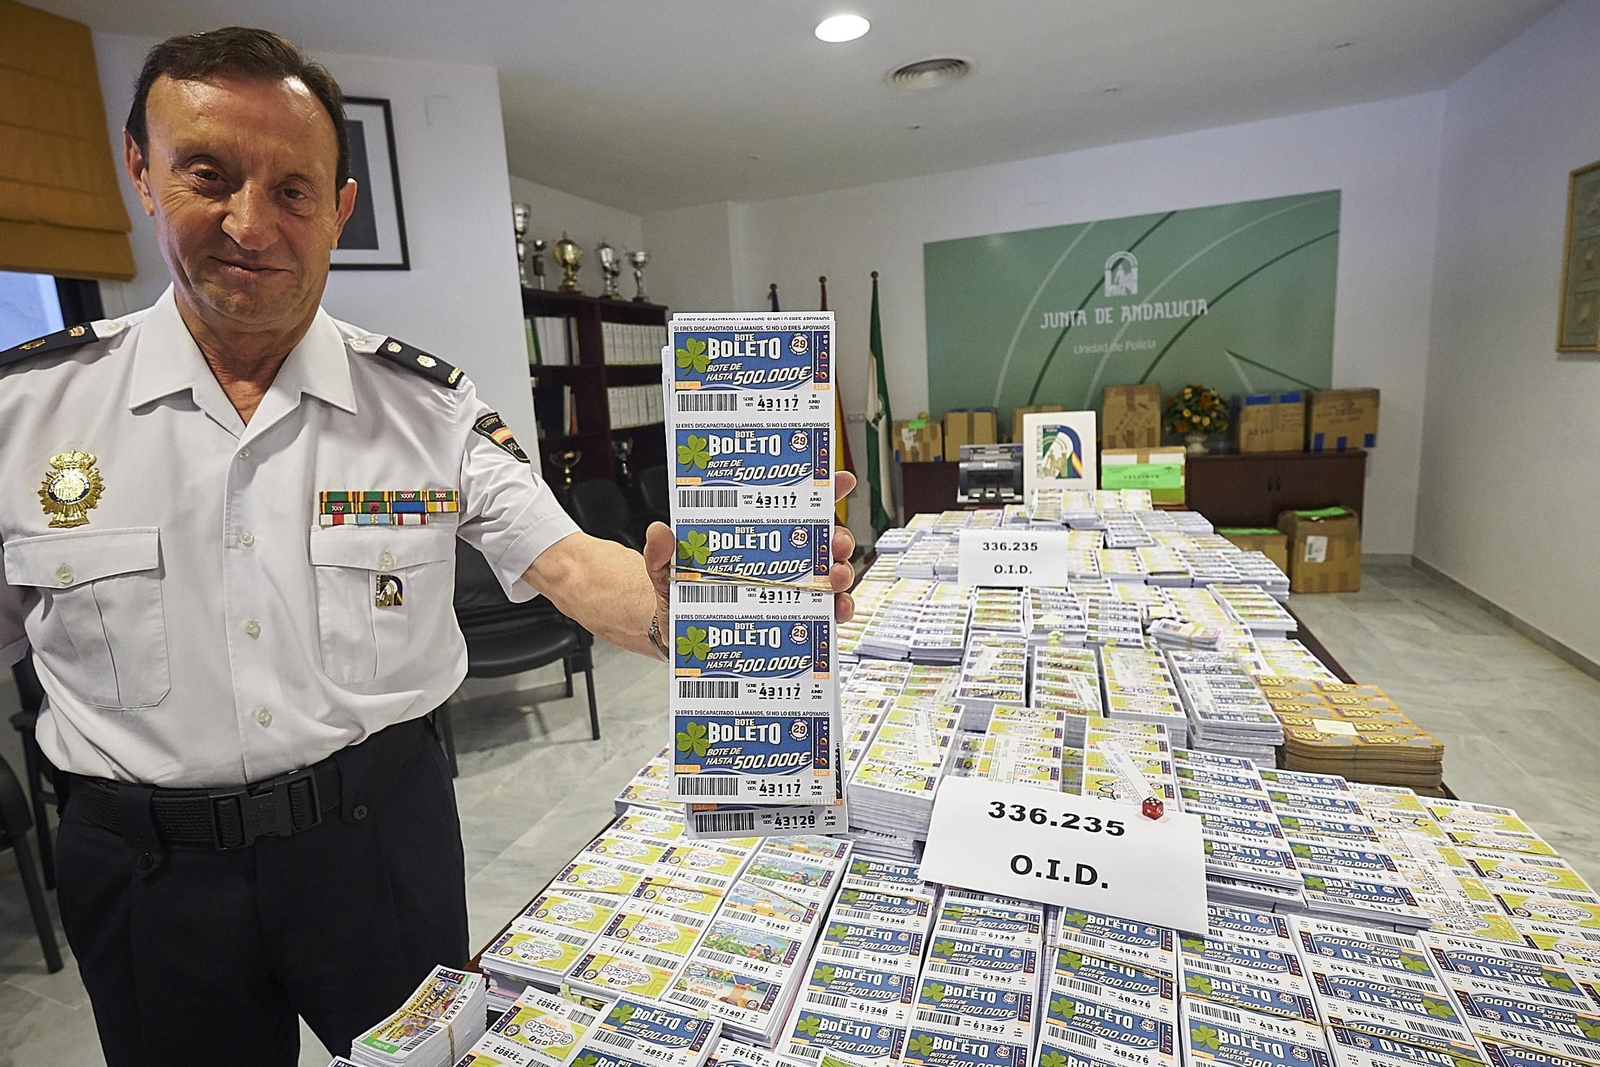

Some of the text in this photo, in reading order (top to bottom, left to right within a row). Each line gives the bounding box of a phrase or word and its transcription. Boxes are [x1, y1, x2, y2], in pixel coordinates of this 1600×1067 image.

[1041, 310, 1087, 329] JUNTA
[1095, 307, 1113, 324] DE
[708, 338, 780, 360] BOLETO
[794, 339, 806, 349] 29
[1074, 343, 1106, 354] Unidad
[1110, 343, 1123, 352] de
[706, 364, 728, 372] BOTE
[706, 366, 811, 385] HASTA 500.000€
[758, 399, 798, 409] 43117
[709, 434, 780, 456] BOLETO
[794, 436, 806, 446] 29
[708, 460, 729, 468] BOTE
[733, 463, 811, 482] 500.000€
[756, 496, 796, 505] 43117
[708, 530, 780, 552] BOLETO
[794, 532, 806, 542] 29
[983, 542, 1038, 551] 336.235
[733, 559, 811, 576] 500.000€
[994, 565, 1032, 574] O.I.D.
[760, 591, 800, 600] 43117
[708, 626, 780, 648] BOLETO
[794, 628, 806, 638] 29
[706, 652, 728, 660] BOTE
[706, 655, 811, 673] HASTA 500.000€
[759, 687, 800, 696] 43117
[735, 718, 755, 726] BOTE
[794, 724, 806, 734] 29
[708, 722, 781, 744] BOLETO
[732, 752, 811, 769] 500.000€
[760, 784, 800, 793] 43117
[775, 815, 815, 826] 43128
[988, 801, 1126, 837] 336.235
[1010, 854, 1109, 889] O.I.D.
[1324, 877, 1377, 894] BOLETO
[1087, 914, 1138, 934] BOLETO
[847, 926, 892, 941] BOLETO
[744, 962, 768, 973] 51401
[834, 967, 882, 985] BOLETO
[1099, 975, 1158, 993] 500.000€
[847, 988, 900, 1000] 500.000€
[944, 984, 996, 1004] BOLETO
[536, 999, 561, 1012] 32802
[719, 1006, 746, 1019] 51401
[859, 1005, 888, 1014] 61348
[960, 1005, 1017, 1018] 500.000€
[632, 1007, 682, 1030] BOLETO
[1075, 1001, 1133, 1029] BOLETO
[820, 1018, 871, 1039] BOLETO
[974, 1022, 1005, 1033] 61347
[1259, 1021, 1296, 1035] 43142
[638, 1028, 692, 1046] 500.000€
[1093, 1026, 1158, 1048] 500.000€
[1217, 1028, 1284, 1059] BOLETO
[832, 1041, 890, 1055] 500.000€
[932, 1036, 989, 1058] BOLETO
[1113, 1048, 1149, 1064] 48476
